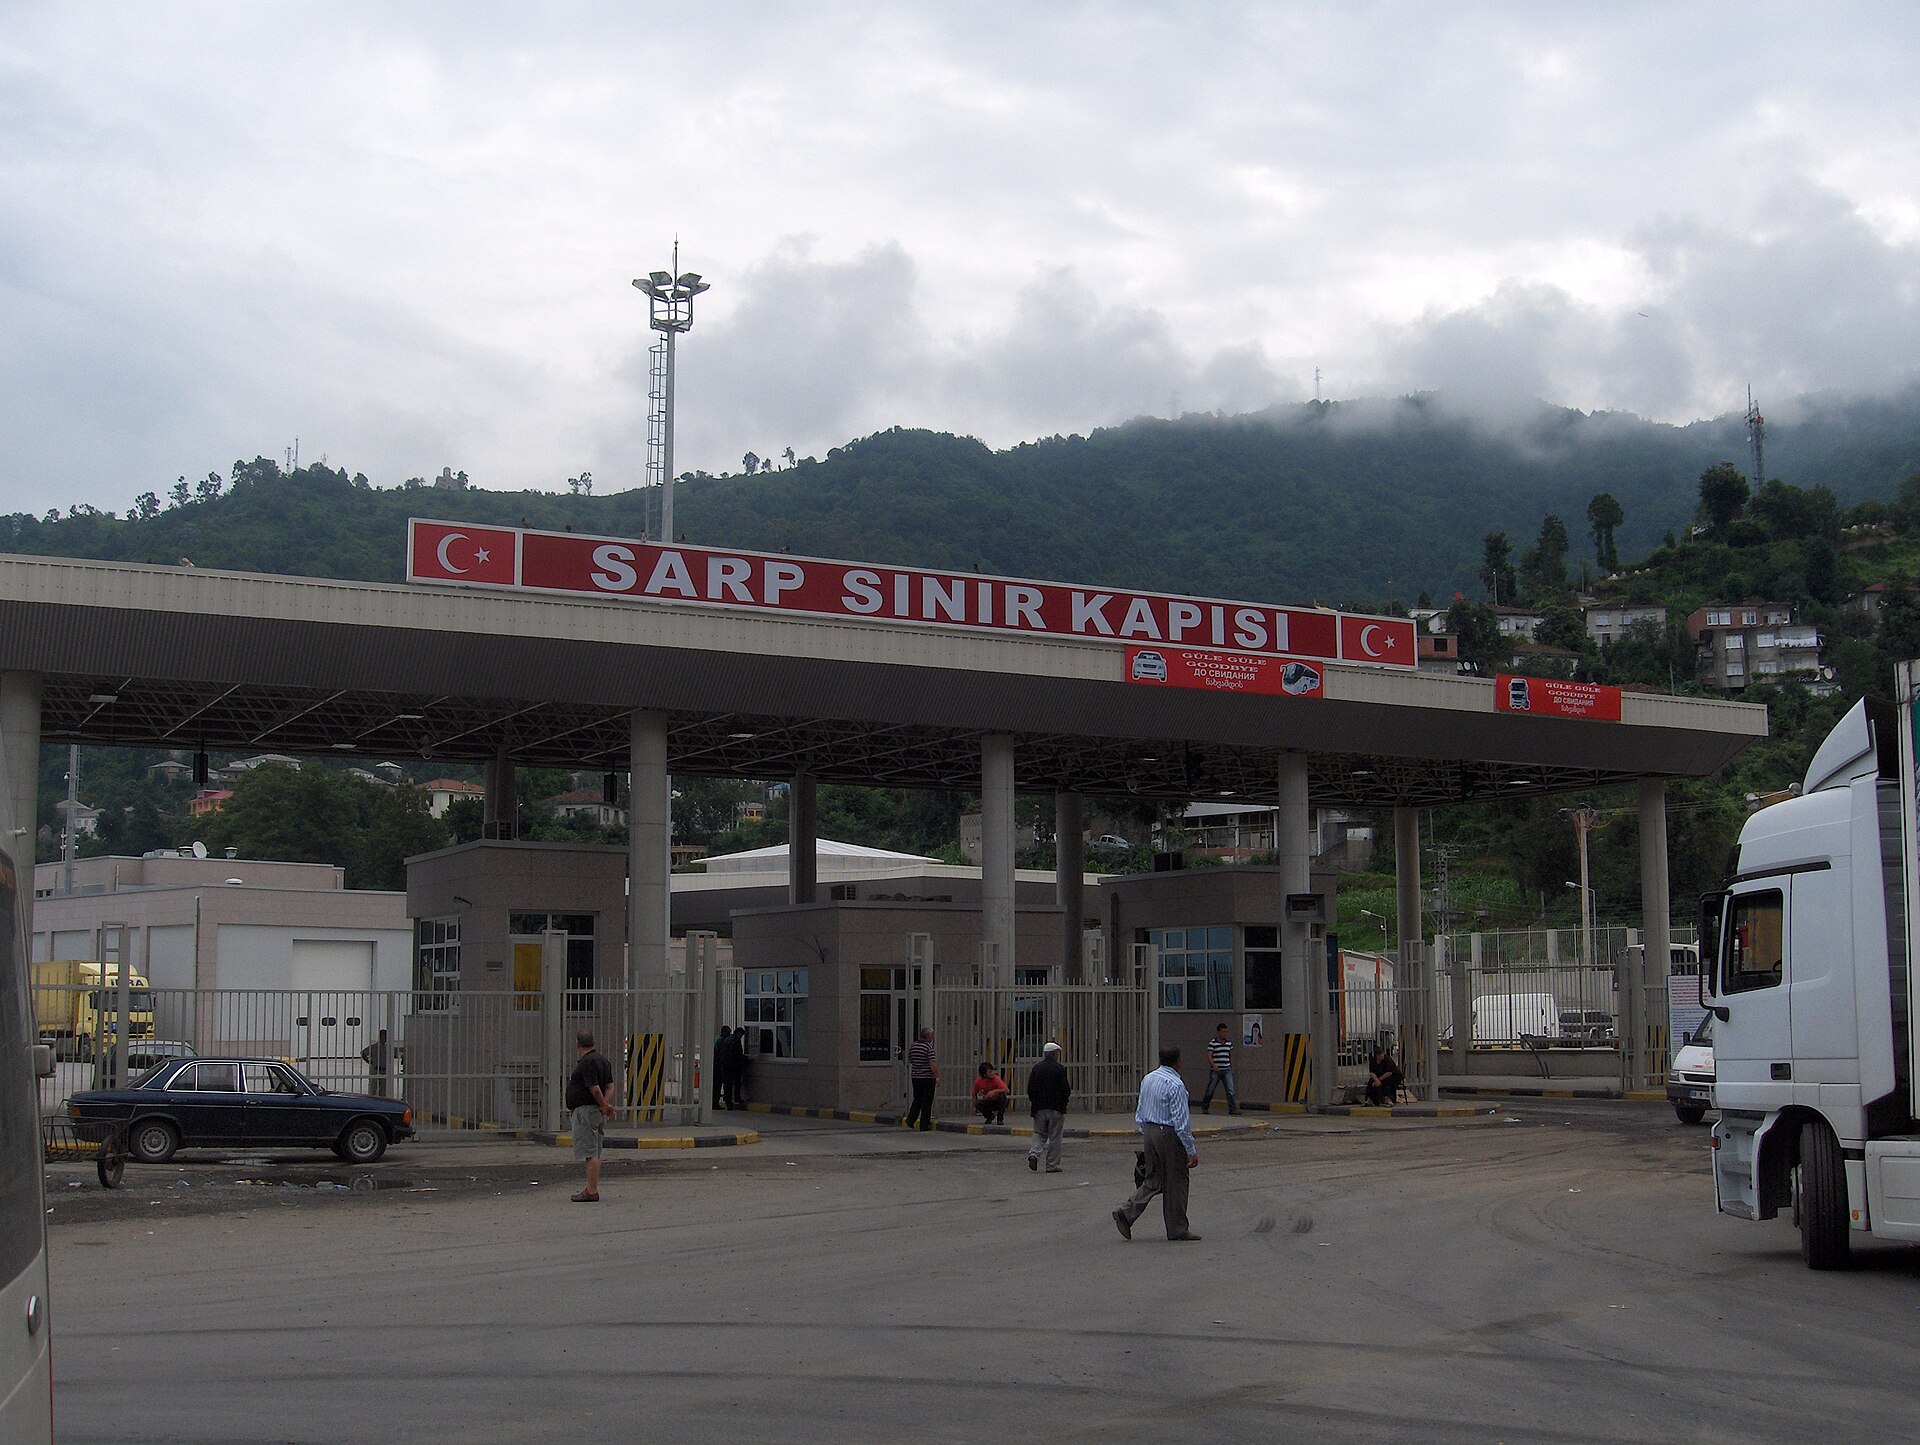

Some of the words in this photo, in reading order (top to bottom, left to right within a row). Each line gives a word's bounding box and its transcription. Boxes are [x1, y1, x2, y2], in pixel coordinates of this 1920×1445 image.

[590, 544, 805, 605] SARP
[841, 569, 1047, 629] SINIR
[1071, 591, 1289, 651] KAPISI
[1182, 652, 1223, 661] GÜLE
[1227, 656, 1267, 666] GÜLE
[1186, 660, 1259, 673] GOODBYE
[1194, 668, 1207, 677] ДО
[1209, 669, 1256, 681] СВИДАНИЯ
[1545, 682, 1572, 690] GÜLE
[1574, 685, 1601, 693] GÜLE
[1548, 689, 1596, 700] GOODBYE
